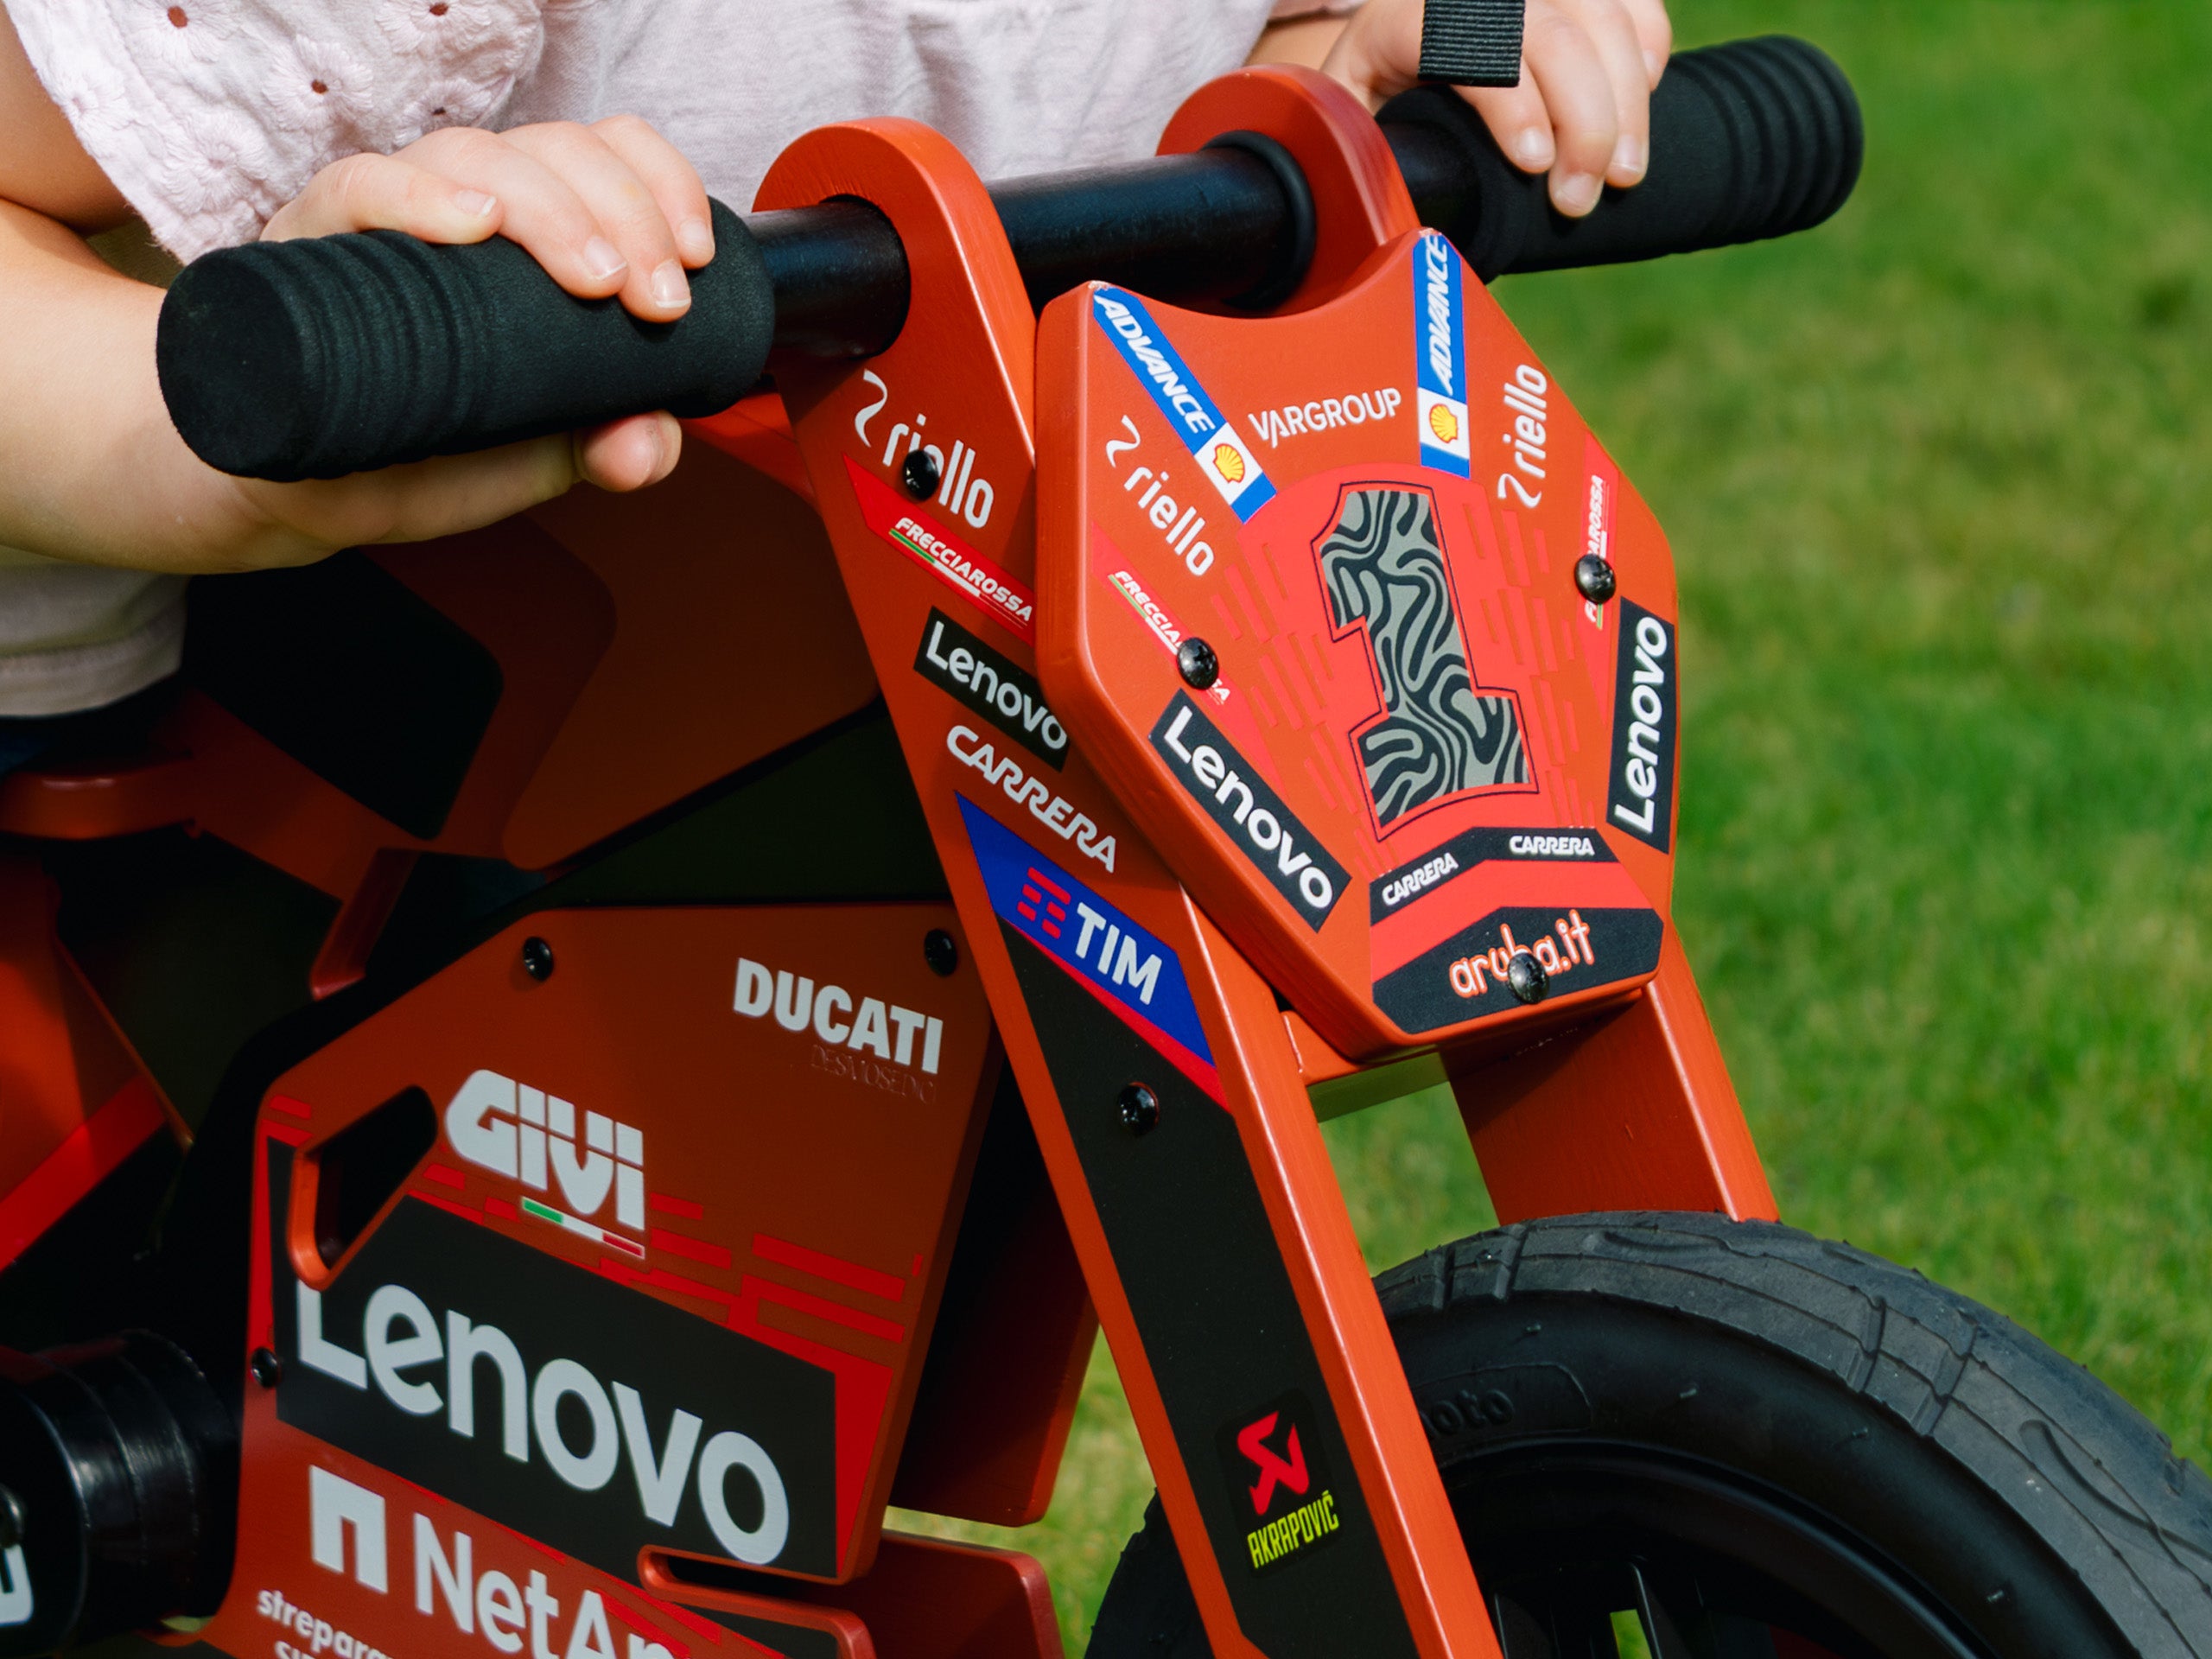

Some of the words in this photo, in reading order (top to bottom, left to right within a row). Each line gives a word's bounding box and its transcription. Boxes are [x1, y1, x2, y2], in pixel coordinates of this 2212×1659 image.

[1093, 295, 1216, 434] ADVANCE
[1426, 234, 1453, 397] ADVANCE
[1248, 387, 1402, 449] VARGROUP
[1503, 365, 1548, 479] riello
[895, 516, 1034, 622] FRECCIAROSSA
[1123, 467, 1215, 576] riello
[1585, 474, 1605, 623] FAROSSA
[926, 620, 1068, 750] Lenovo
[1114, 569, 1231, 702] FRECCIAA
[1614, 616, 1669, 834] Lenovo
[946, 724, 1116, 873] CARRERA
[1163, 705, 1333, 909] Lenovo
[1509, 835, 1596, 856] CARRERA
[1382, 852, 1459, 906] CARRERA
[733, 957, 944, 1074] DUCATI
[1077, 902, 1162, 1005] TIM
[445, 1069, 645, 1232] GIVI
[297, 1280, 790, 1565] Lenovo
[1419, 1389, 1516, 1439] oto
[414, 1512, 676, 1659] NetA
